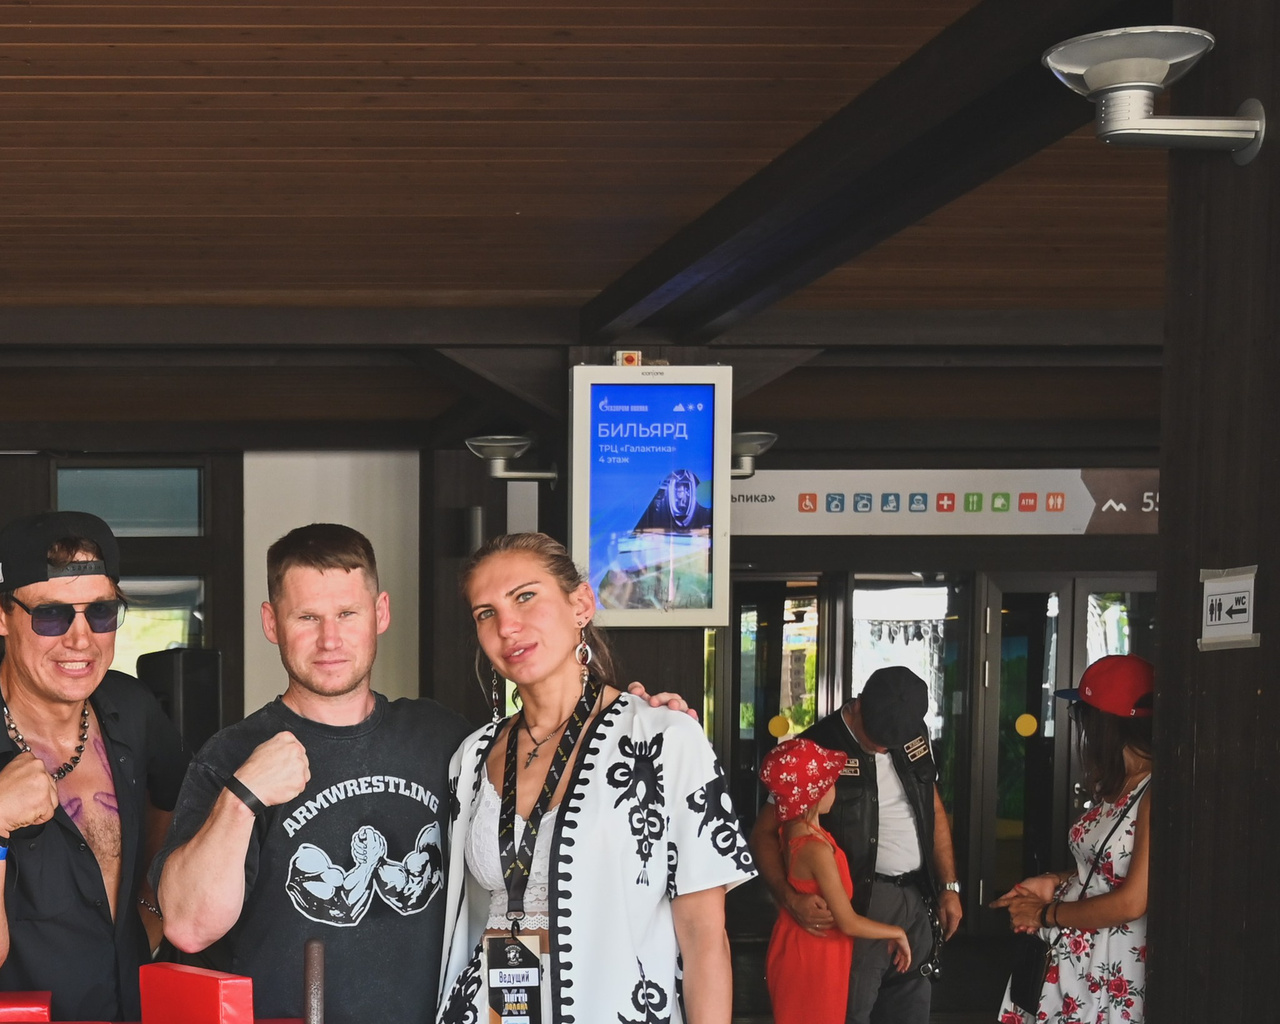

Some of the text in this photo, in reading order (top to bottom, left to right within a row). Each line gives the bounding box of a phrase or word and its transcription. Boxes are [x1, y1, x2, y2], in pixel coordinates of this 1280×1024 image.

[598, 423, 688, 440] БИЛЬЯРД
[599, 444, 677, 454] ТРЦ «Галактика»
[607, 456, 629, 464] этаж
[1234, 595, 1246, 606] WC
[282, 775, 440, 838] ARMWRESTLING
[499, 970, 530, 985] Ведущий
